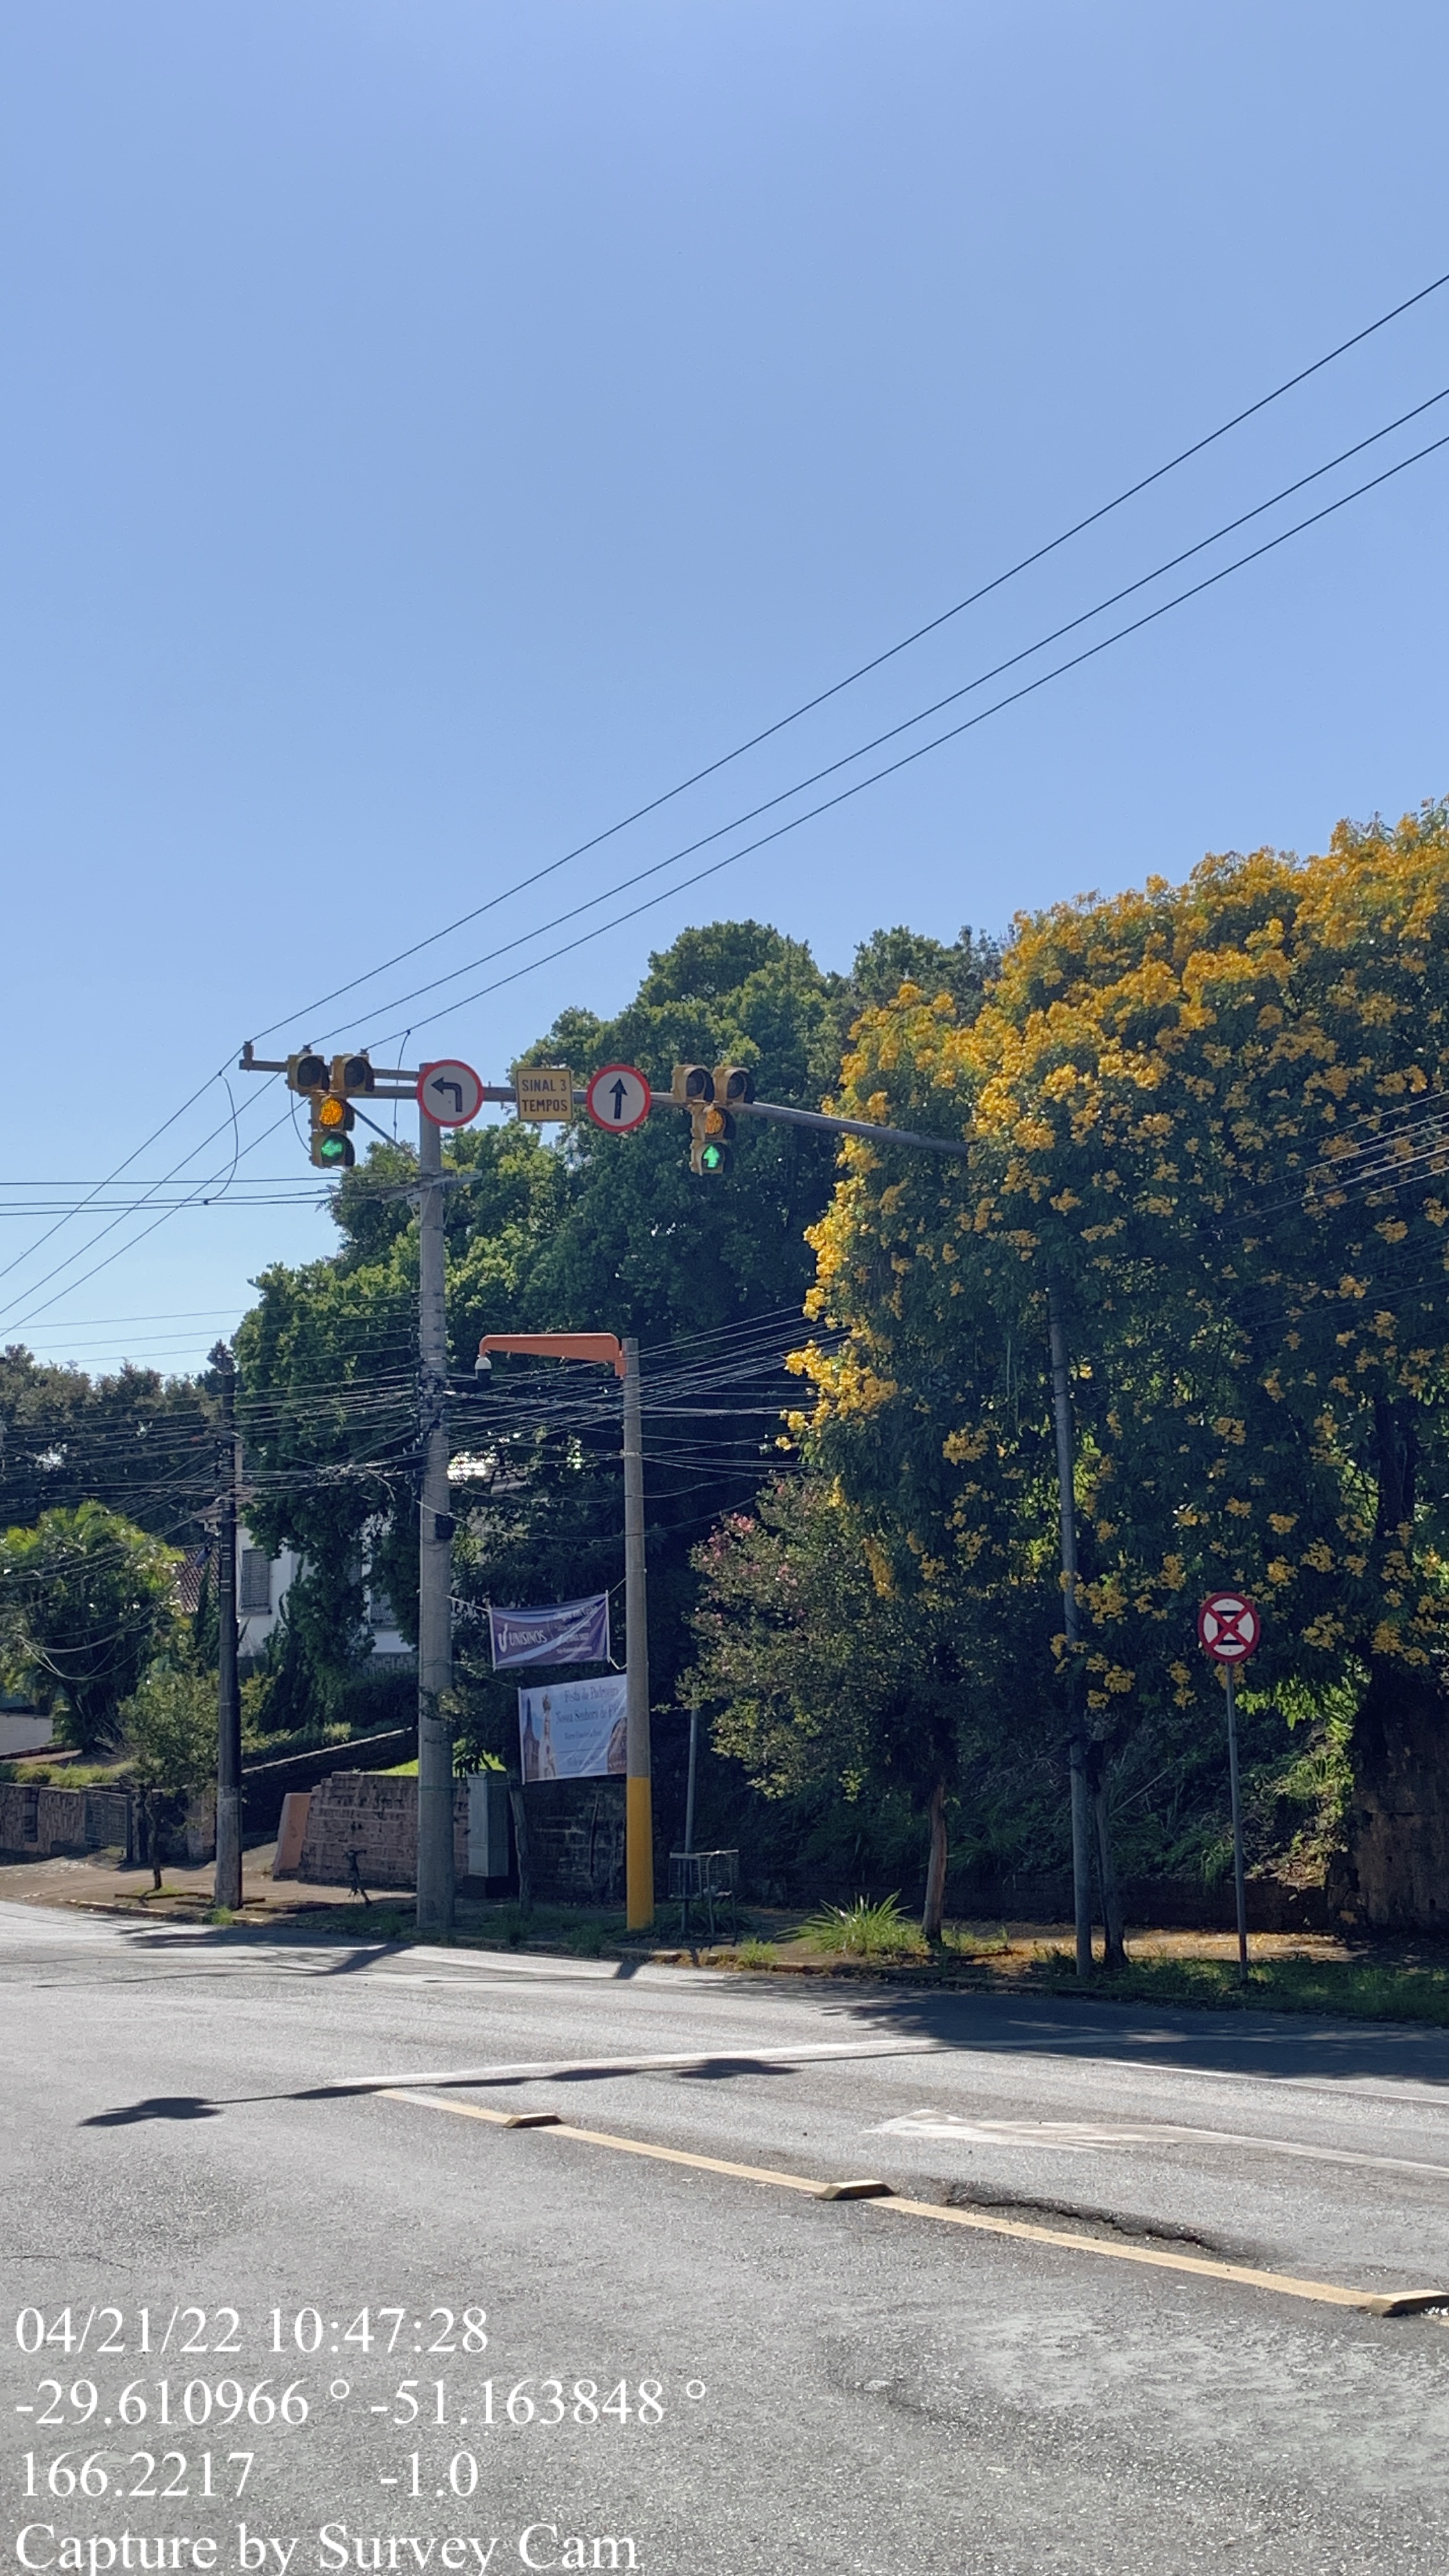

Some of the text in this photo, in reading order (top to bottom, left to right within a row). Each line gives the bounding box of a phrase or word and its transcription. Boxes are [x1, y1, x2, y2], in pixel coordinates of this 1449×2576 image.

[522, 1079, 567, 1092] SINAL 3
[521, 1099, 568, 1112] TEMPOS
